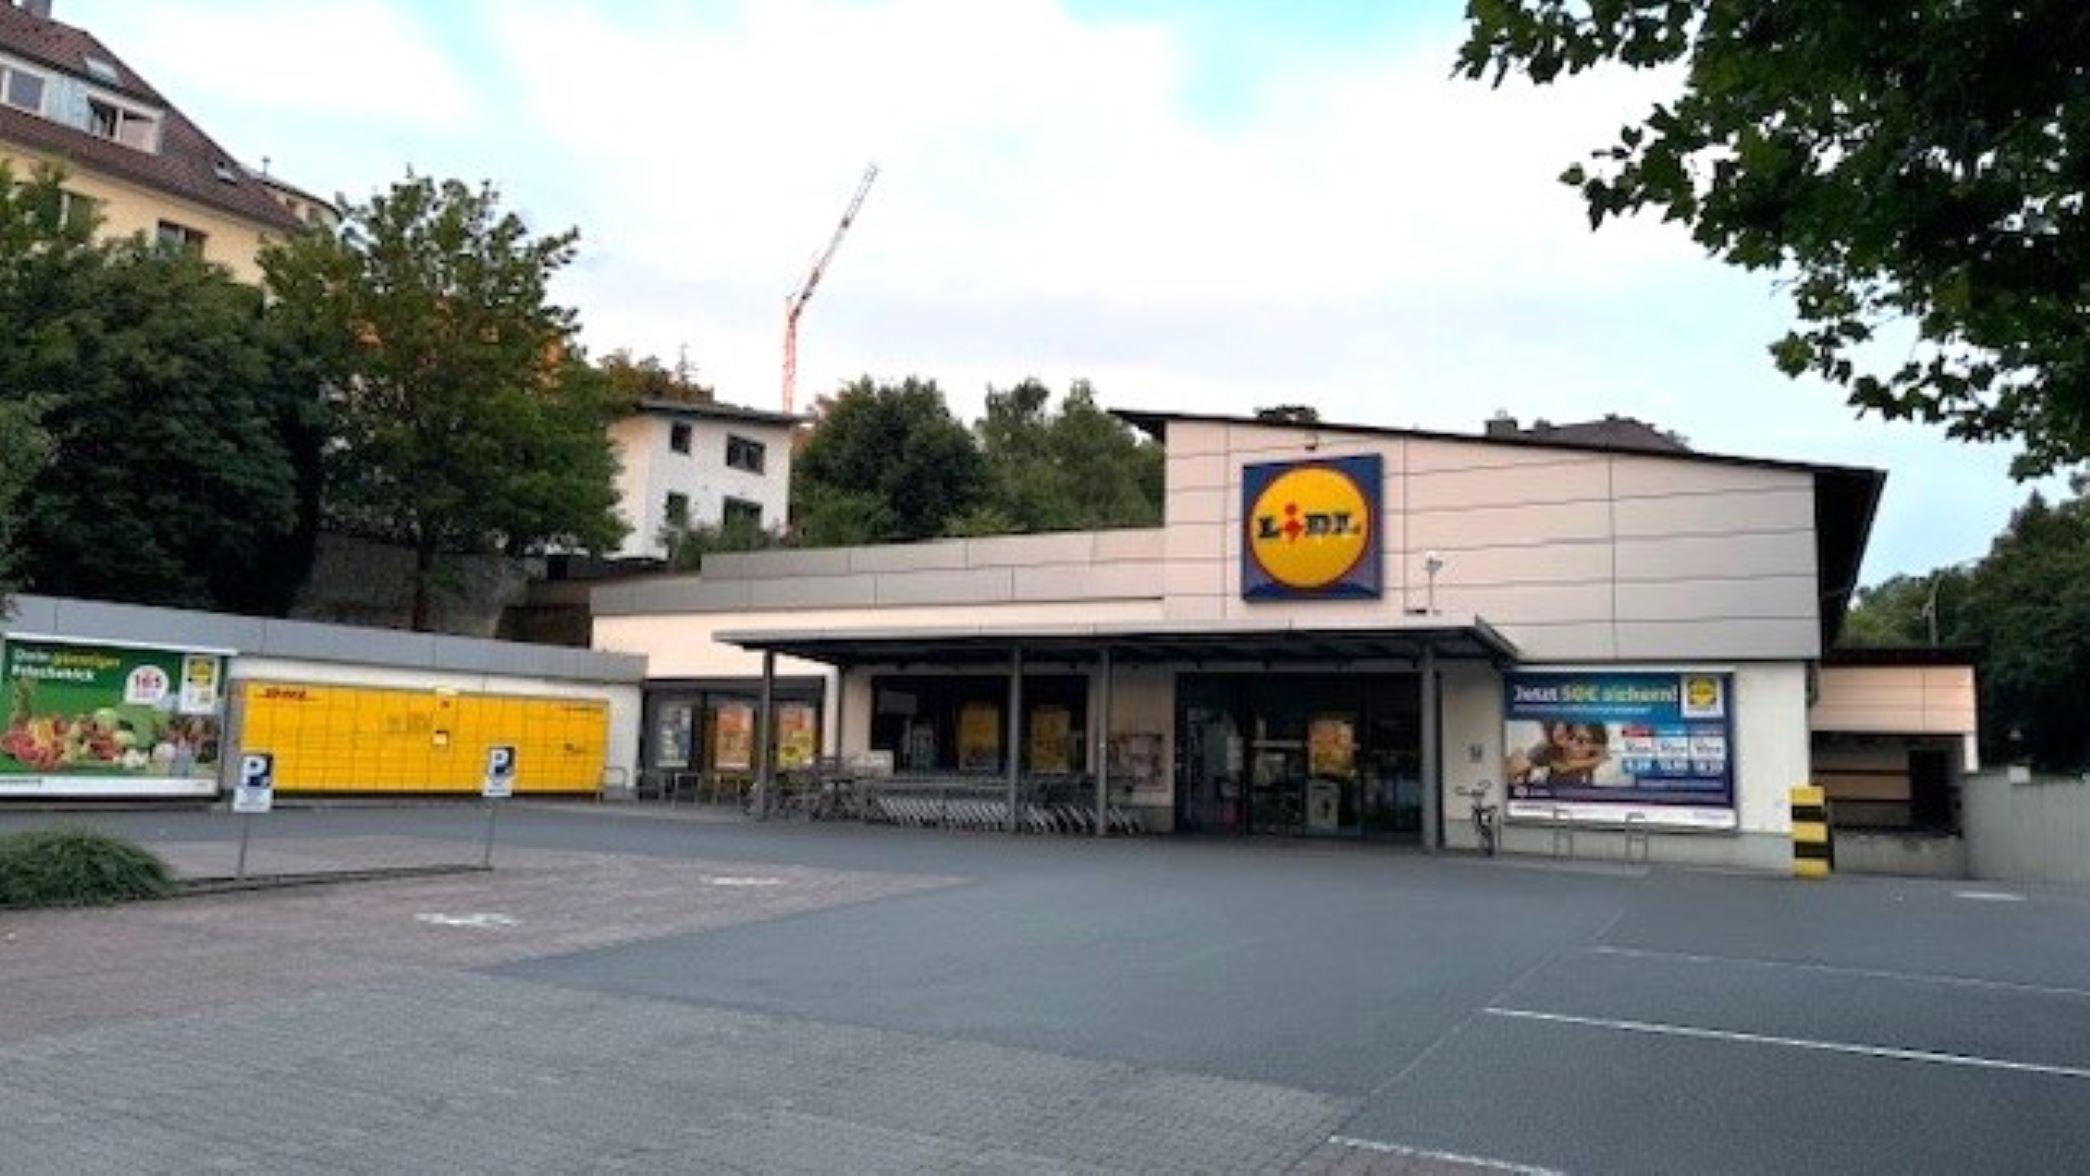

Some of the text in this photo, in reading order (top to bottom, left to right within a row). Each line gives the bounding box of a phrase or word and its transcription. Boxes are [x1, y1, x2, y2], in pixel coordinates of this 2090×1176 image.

[1513, 684, 1557, 702] Jetzt
[1561, 683, 1600, 702] 50€
[1602, 684, 1678, 703] sichern!
[242, 755, 268, 787] P
